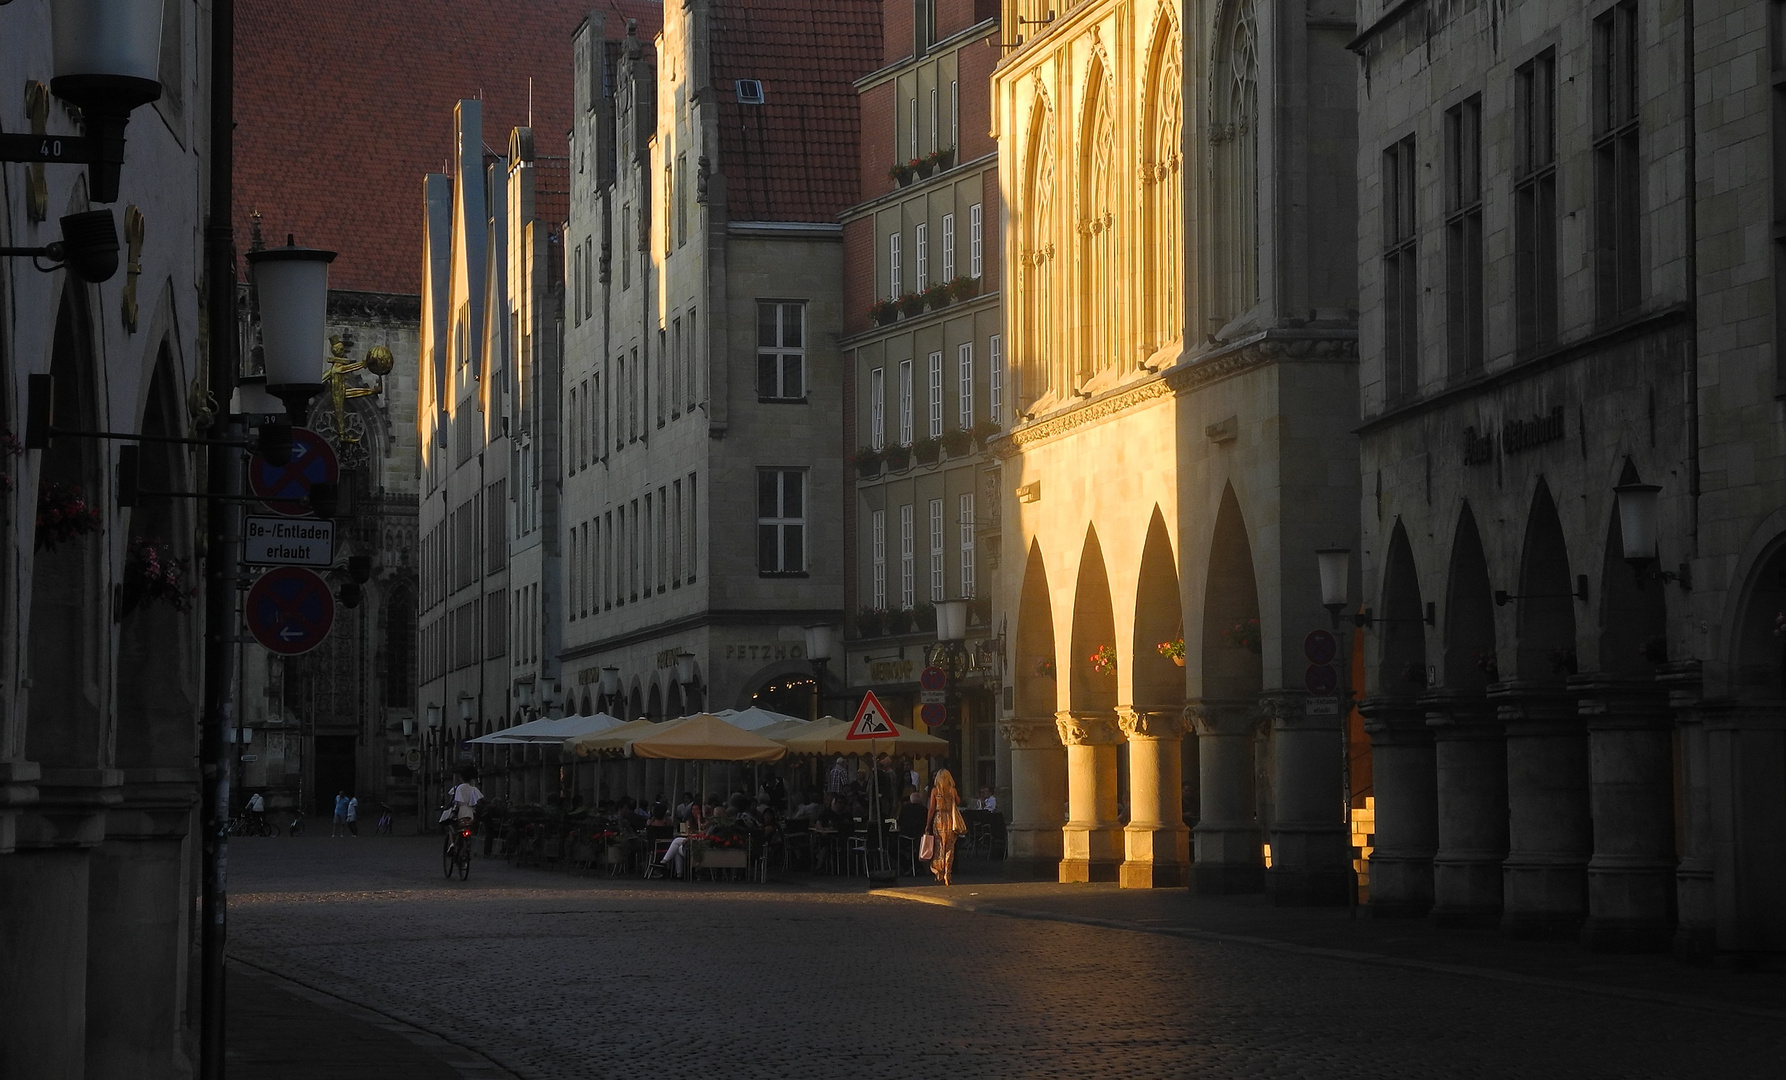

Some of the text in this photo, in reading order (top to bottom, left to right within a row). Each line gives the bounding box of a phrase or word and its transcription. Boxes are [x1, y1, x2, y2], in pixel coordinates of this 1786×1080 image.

[40, 140, 61, 156] 40
[264, 415, 276, 425] 39
[249, 523, 329, 540] Be-/Entladen
[266, 544, 310, 559] erlaubt
